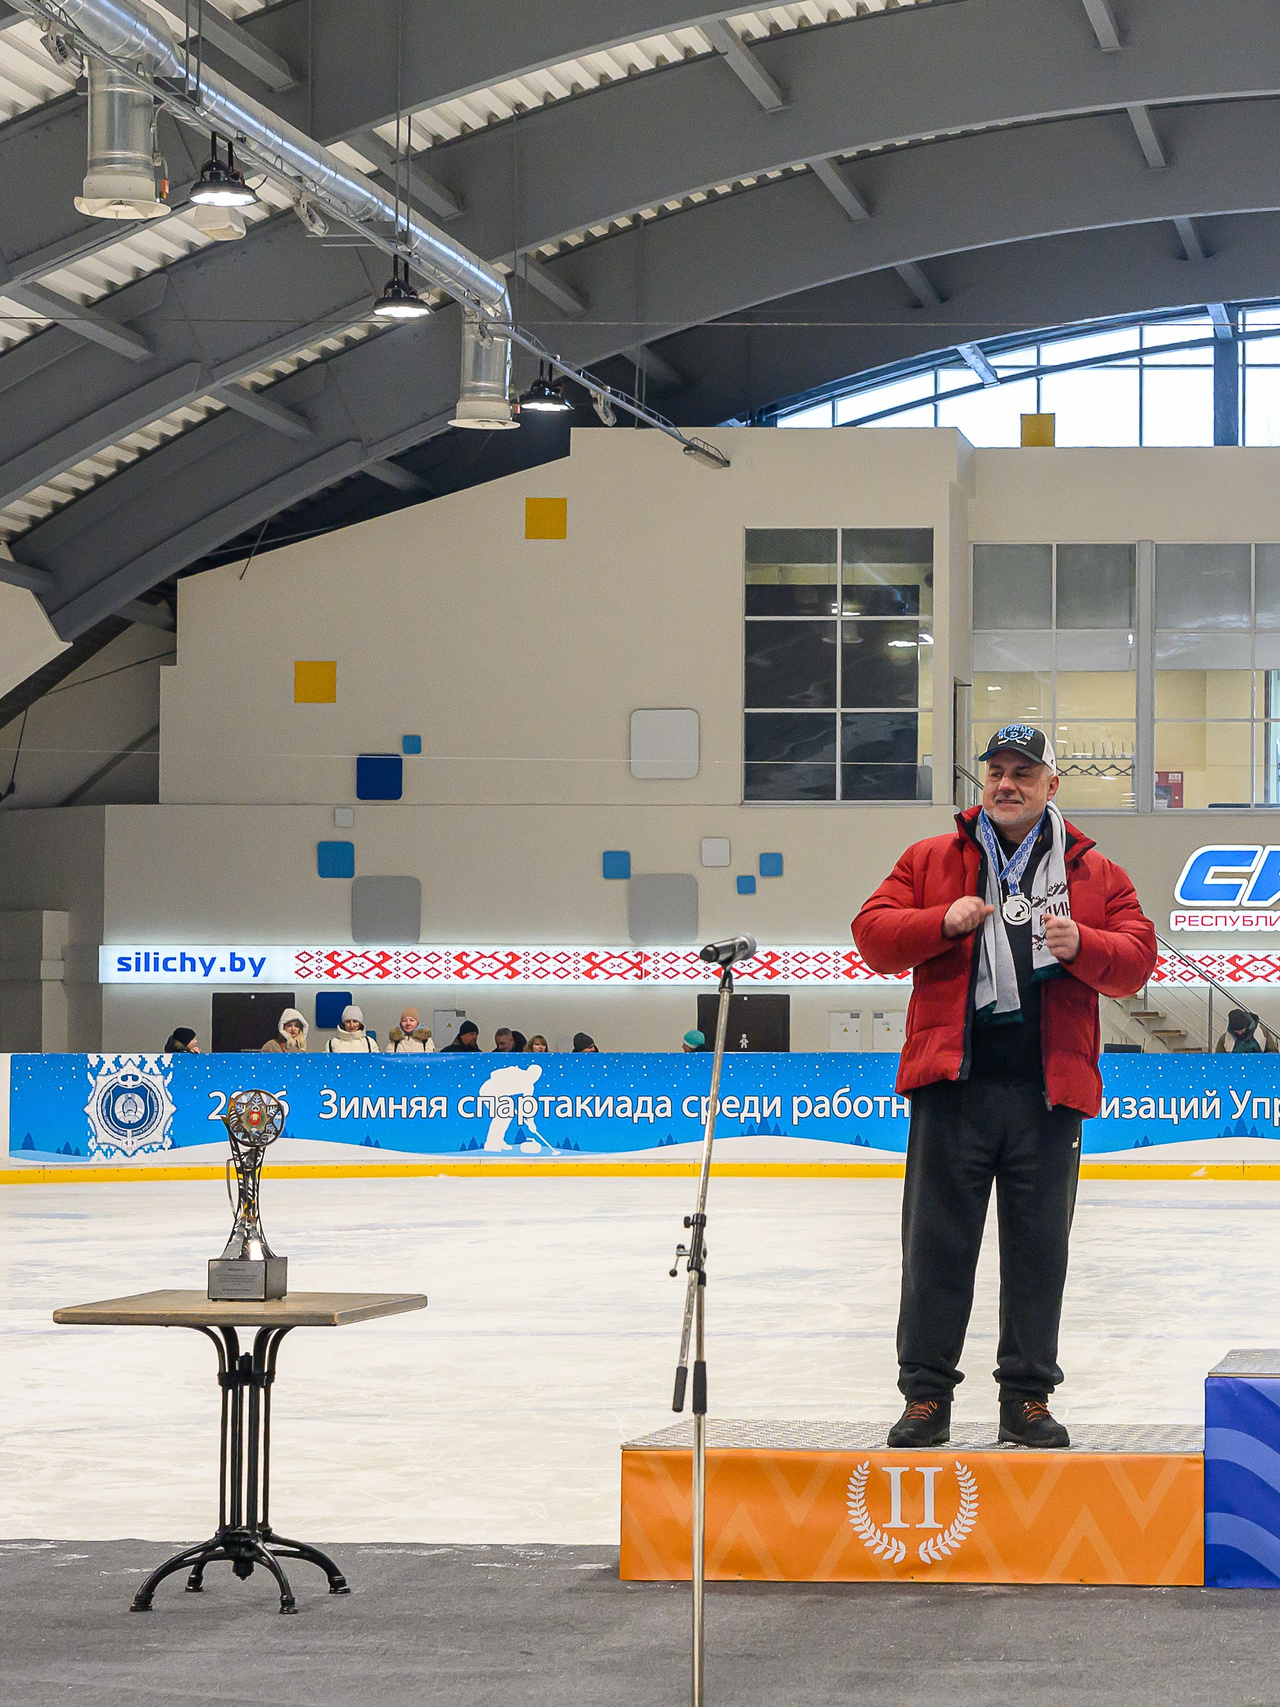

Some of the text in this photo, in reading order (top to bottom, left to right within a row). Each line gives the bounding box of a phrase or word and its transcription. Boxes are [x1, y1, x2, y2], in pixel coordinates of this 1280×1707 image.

[116, 951, 267, 978] silichy.by
[318, 1087, 910, 1126] Зимняя спартакиада среди работн
[881, 1465, 944, 1530] II
